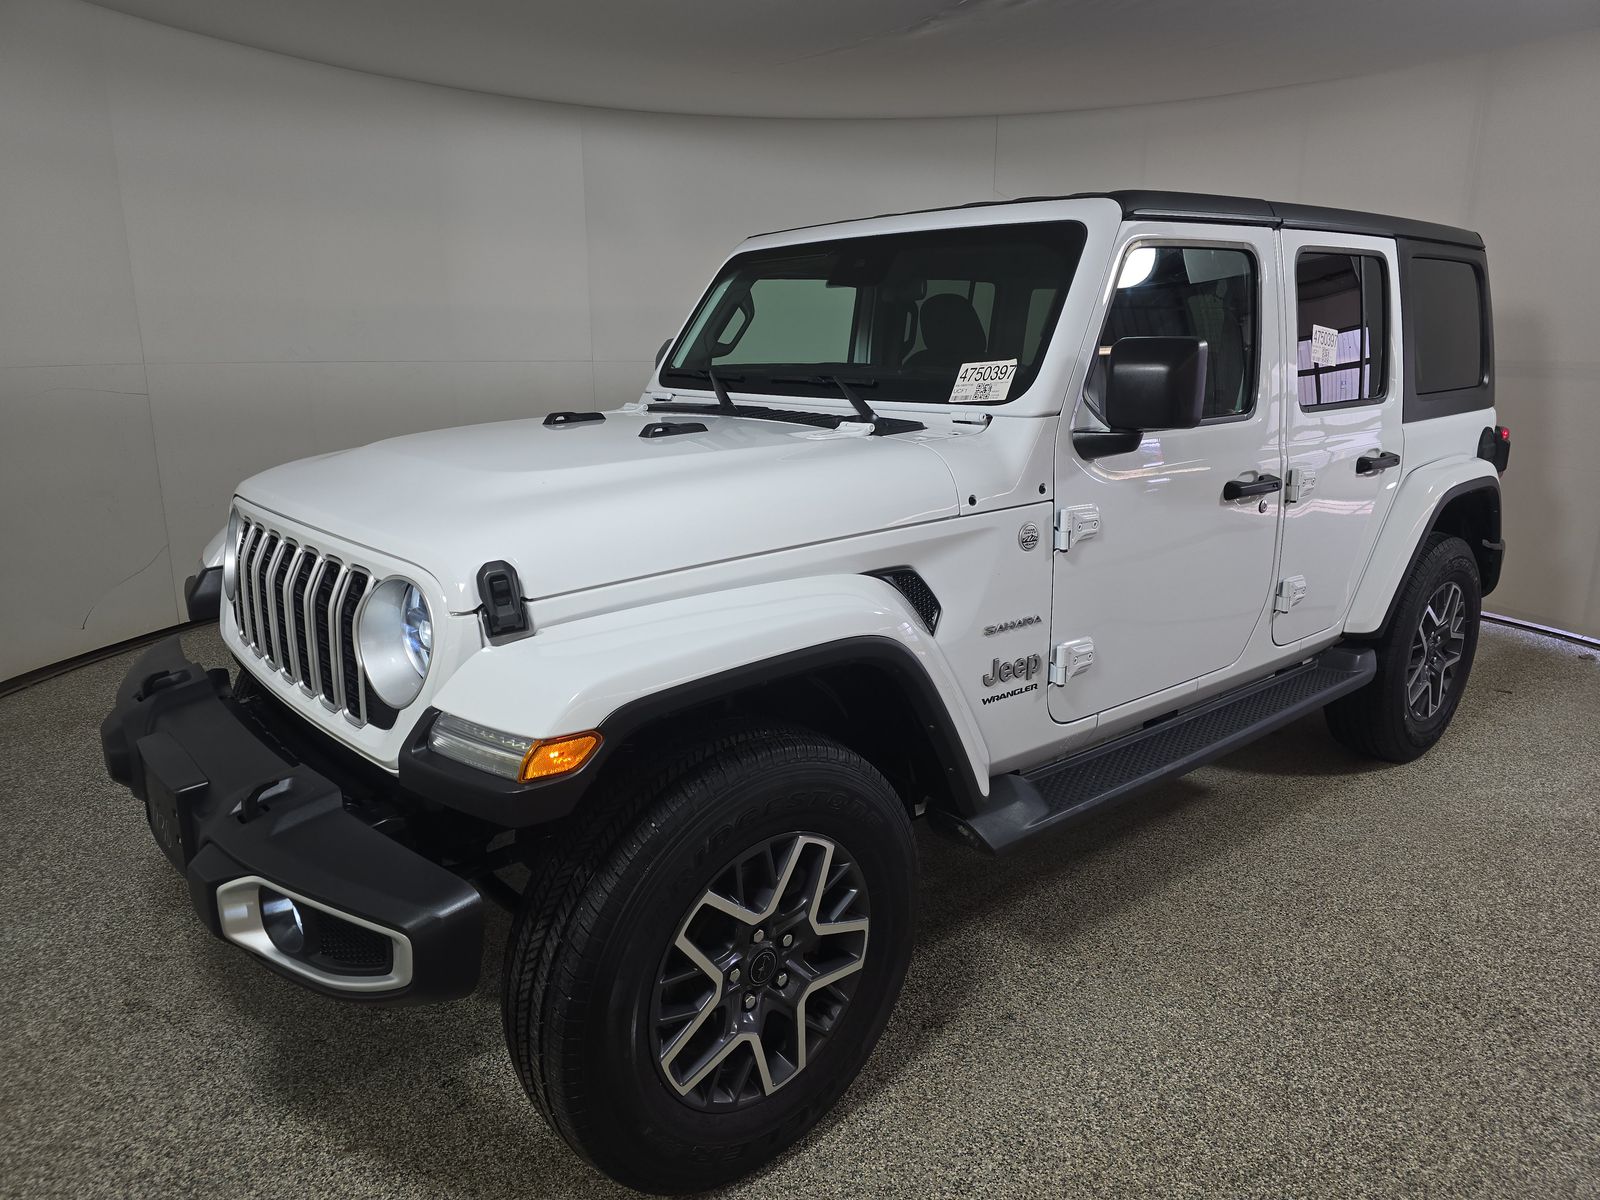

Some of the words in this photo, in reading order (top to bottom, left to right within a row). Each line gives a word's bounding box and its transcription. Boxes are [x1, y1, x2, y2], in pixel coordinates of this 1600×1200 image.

[959, 365, 1017, 382] 4750397
[983, 615, 1042, 637] SAHARA
[982, 653, 1042, 688] Jeep
[981, 683, 1038, 706] WRANGLER
